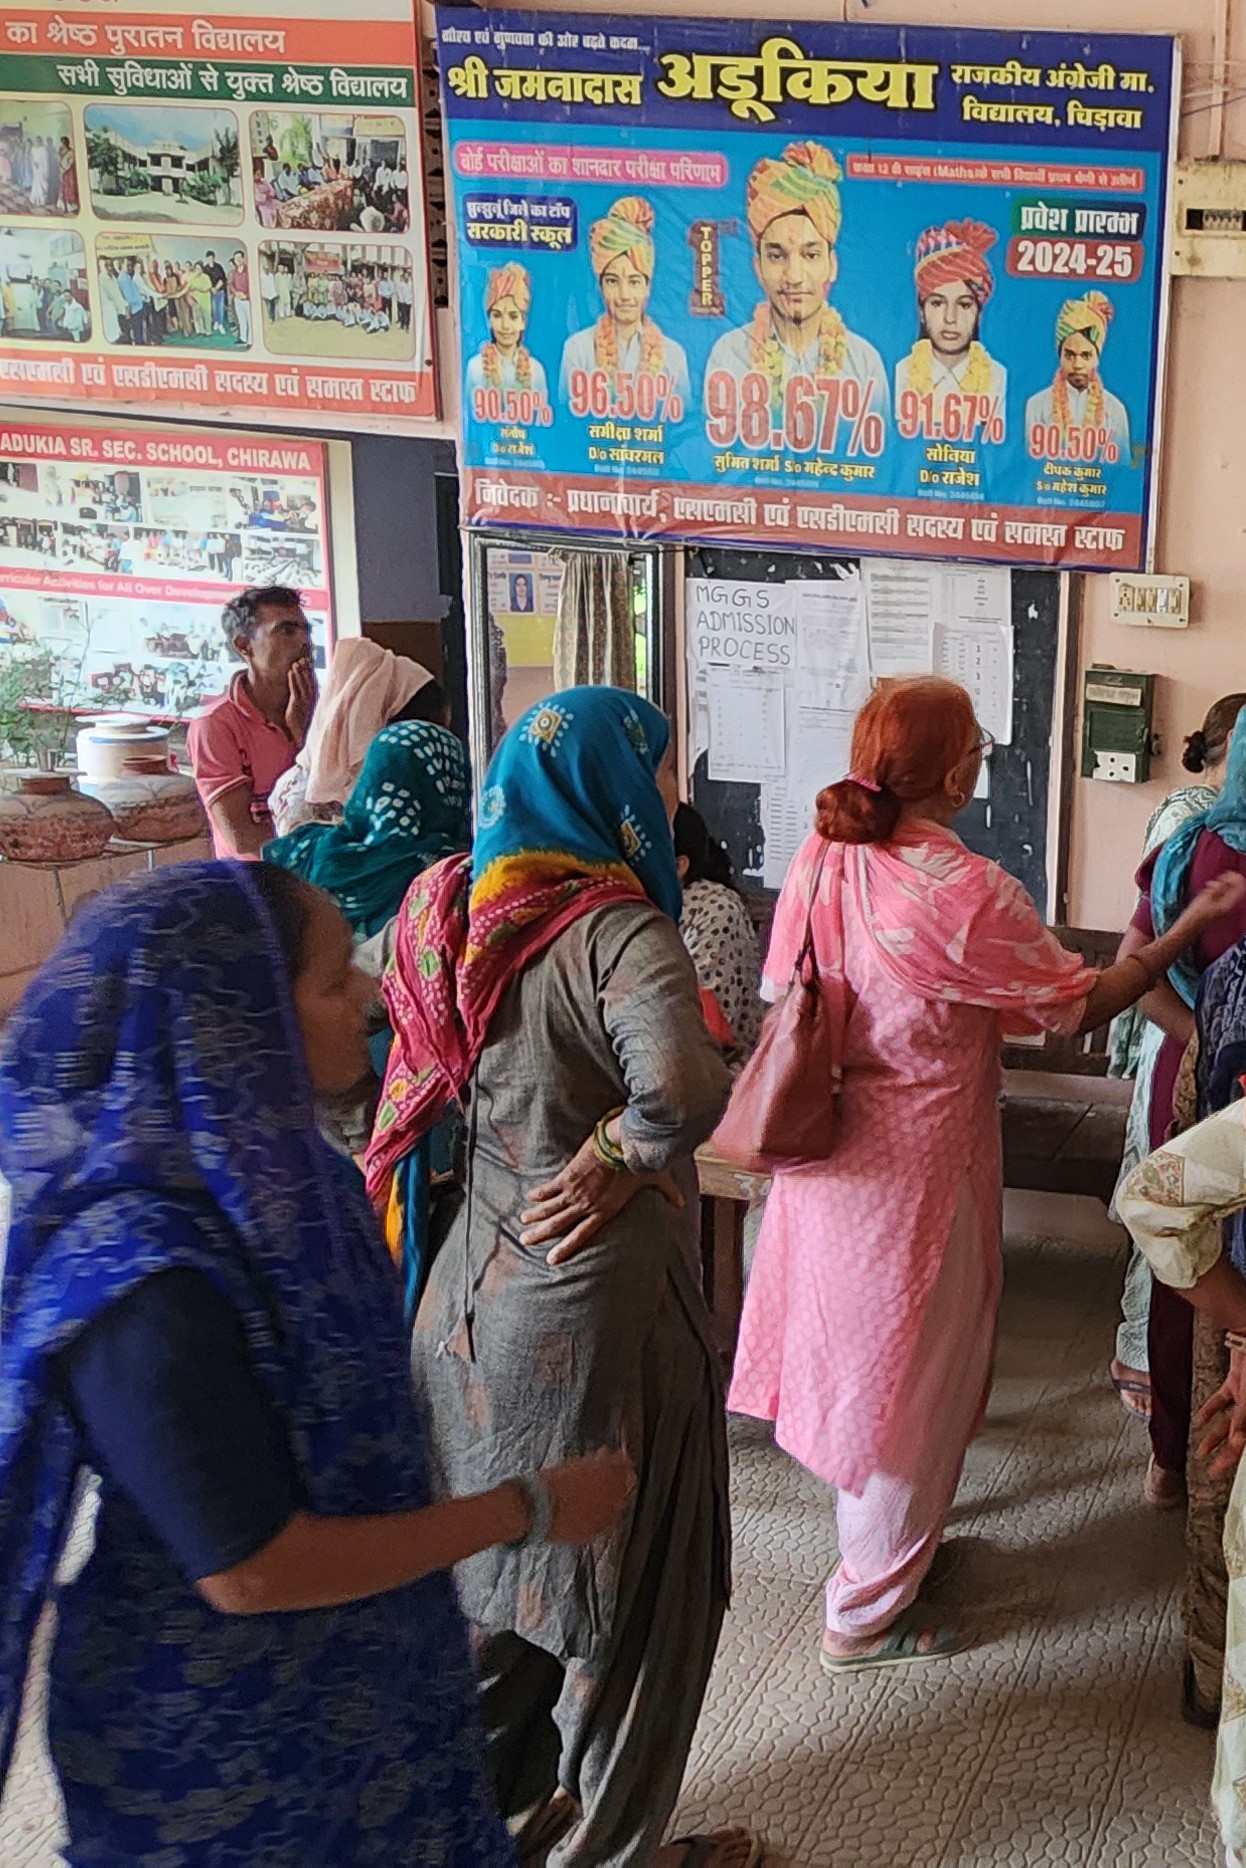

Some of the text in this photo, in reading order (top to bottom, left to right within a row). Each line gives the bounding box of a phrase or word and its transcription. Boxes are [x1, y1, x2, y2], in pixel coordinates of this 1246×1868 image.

[5, 14, 286, 55] का श्रेष्ठ पुरातन विद्यालय
[538, 31, 554, 46] की
[557, 33, 579, 48] ओर
[57, 59, 408, 100] सभी सुविधाओं से युक्त श्रेष्ठ विद्यालय
[447, 54, 644, 105] श्री जमनादास
[657, 37, 939, 123] अडूकिया
[951, 60, 1155, 94] राजकीय अंग्रेजी मा.
[962, 95, 1144, 132] विद्यालय, चिड़ावा
[460, 146, 722, 185] बोर्ड परीक्षाओं का शानदार परीक्षा परिणाम
[530, 204, 548, 217] का
[548, 202, 571, 218] टॉप
[1019, 200, 1140, 236] प्रवेश प्रारम्भ
[466, 218, 573, 250] सरकारी स्कूल
[699, 226, 714, 306] TOPPER
[1017, 240, 1133, 277] 2024-25
[80, 356, 105, 386] एवं
[111, 361, 209, 392] एसडीएमसी
[214, 370, 269, 394] सदस्य
[275, 366, 300, 398] एवं
[306, 374, 364, 402] समस्त
[370, 379, 417, 404] स्टाफ
[569, 370, 683, 423] 96.50%
[474, 387, 552, 426] 90.50%
[706, 371, 885, 457] 98.67%
[898, 389, 1004, 444] 91.67%
[588, 421, 663, 443] समीक्षा शर्मा
[1030, 423, 1120, 465] 90.50%
[0, 433, 312, 471] ADUKIA SR. SEC. SCHOOL, CHIRAWA
[588, 444, 665, 464] D/o सांवरमल
[714, 451, 749, 473] सुमित
[752, 455, 780, 472] शर्मा
[784, 460, 802, 473] S/o
[840, 463, 876, 482] कुमार
[925, 443, 977, 464] सोनिया
[919, 467, 981, 487] D/o राजेश
[1051, 478, 1078, 494] महेश
[1078, 483, 1108, 497] कुमार
[1073, 466, 1102, 481] कुमार
[474, 477, 541, 509] निवेदक
[566, 487, 668, 523] प्रधानाचार्य,
[673, 496, 758, 526] एसएमसी
[763, 498, 789, 528] एवं
[796, 505, 901, 537] एसडीएमसी
[906, 513, 966, 542] सदस्य
[971, 511, 998, 544] एवं
[1004, 521, 1068, 549] समस्त
[1073, 526, 1126, 551] स्टाफ
[98, 580, 116, 592] for
[117, 581, 133, 593] All
[135, 583, 163, 595] Over
[696, 610, 795, 635] ADMISSION
[698, 635, 791, 665] PROCESS
